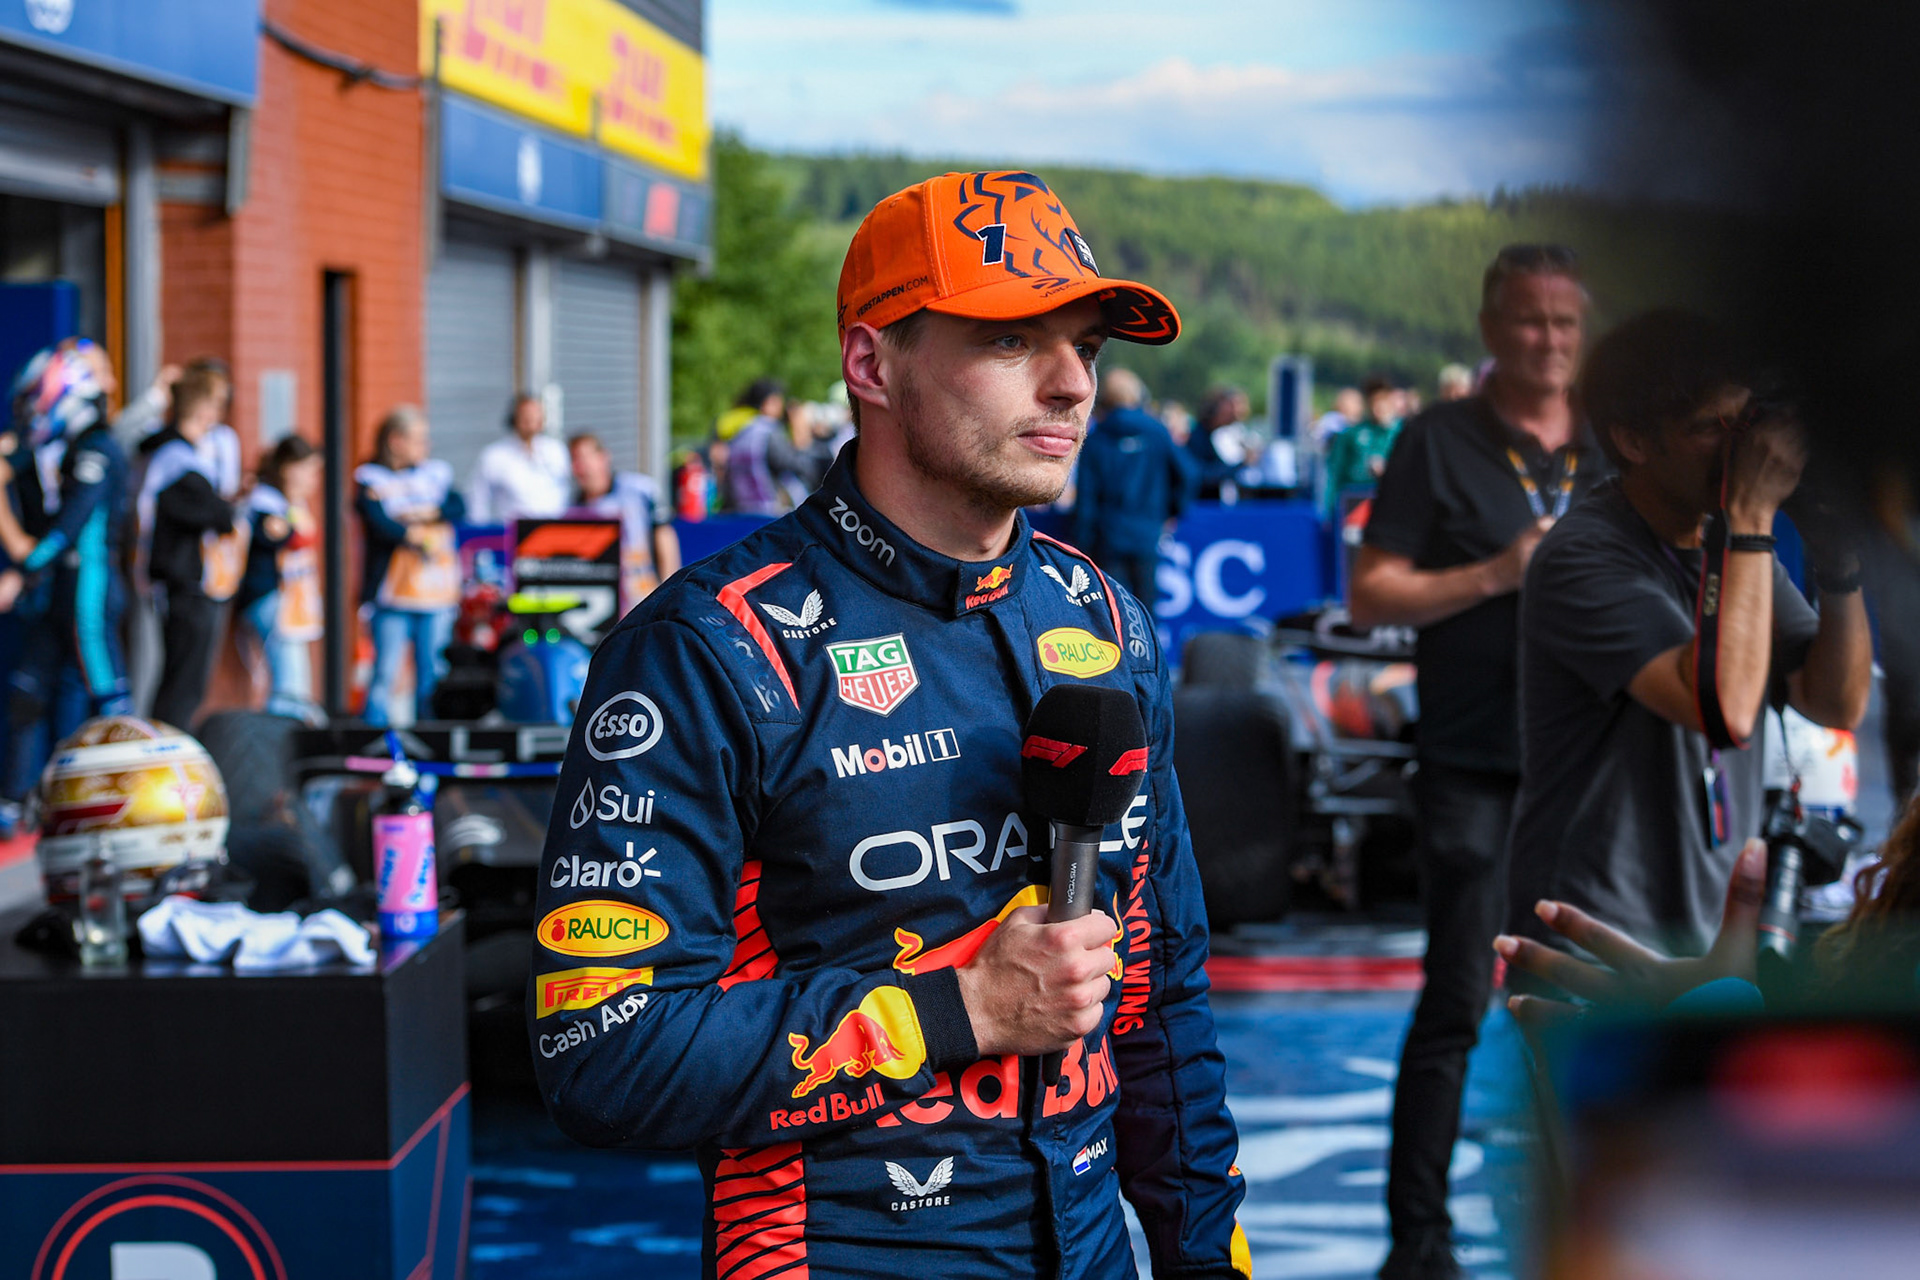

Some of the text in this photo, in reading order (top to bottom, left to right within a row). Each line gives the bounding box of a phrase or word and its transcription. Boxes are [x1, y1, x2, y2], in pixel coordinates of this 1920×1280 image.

[976, 223, 1006, 266] 1
[856, 275, 928, 317] VERSTAPPEN.COM
[829, 496, 896, 568] zoom
[783, 617, 837, 639] CASTORE
[836, 643, 901, 671] TAG
[1056, 642, 1109, 663] RAUCH
[842, 672, 911, 708] HEUER
[831, 731, 953, 779] Mobil 1
[596, 784, 656, 825] Sui
[849, 795, 1148, 892] ORAE
[550, 854, 643, 889] Claro
[567, 917, 650, 940] RAUCH
[545, 970, 642, 1008] PIRELL
[538, 991, 650, 1059] Cash App
[769, 1082, 886, 1131] Red Bull
[876, 1054, 1020, 1128] ed
[1086, 1136, 1108, 1163] MAX
[891, 1195, 951, 1212] CASTORE
